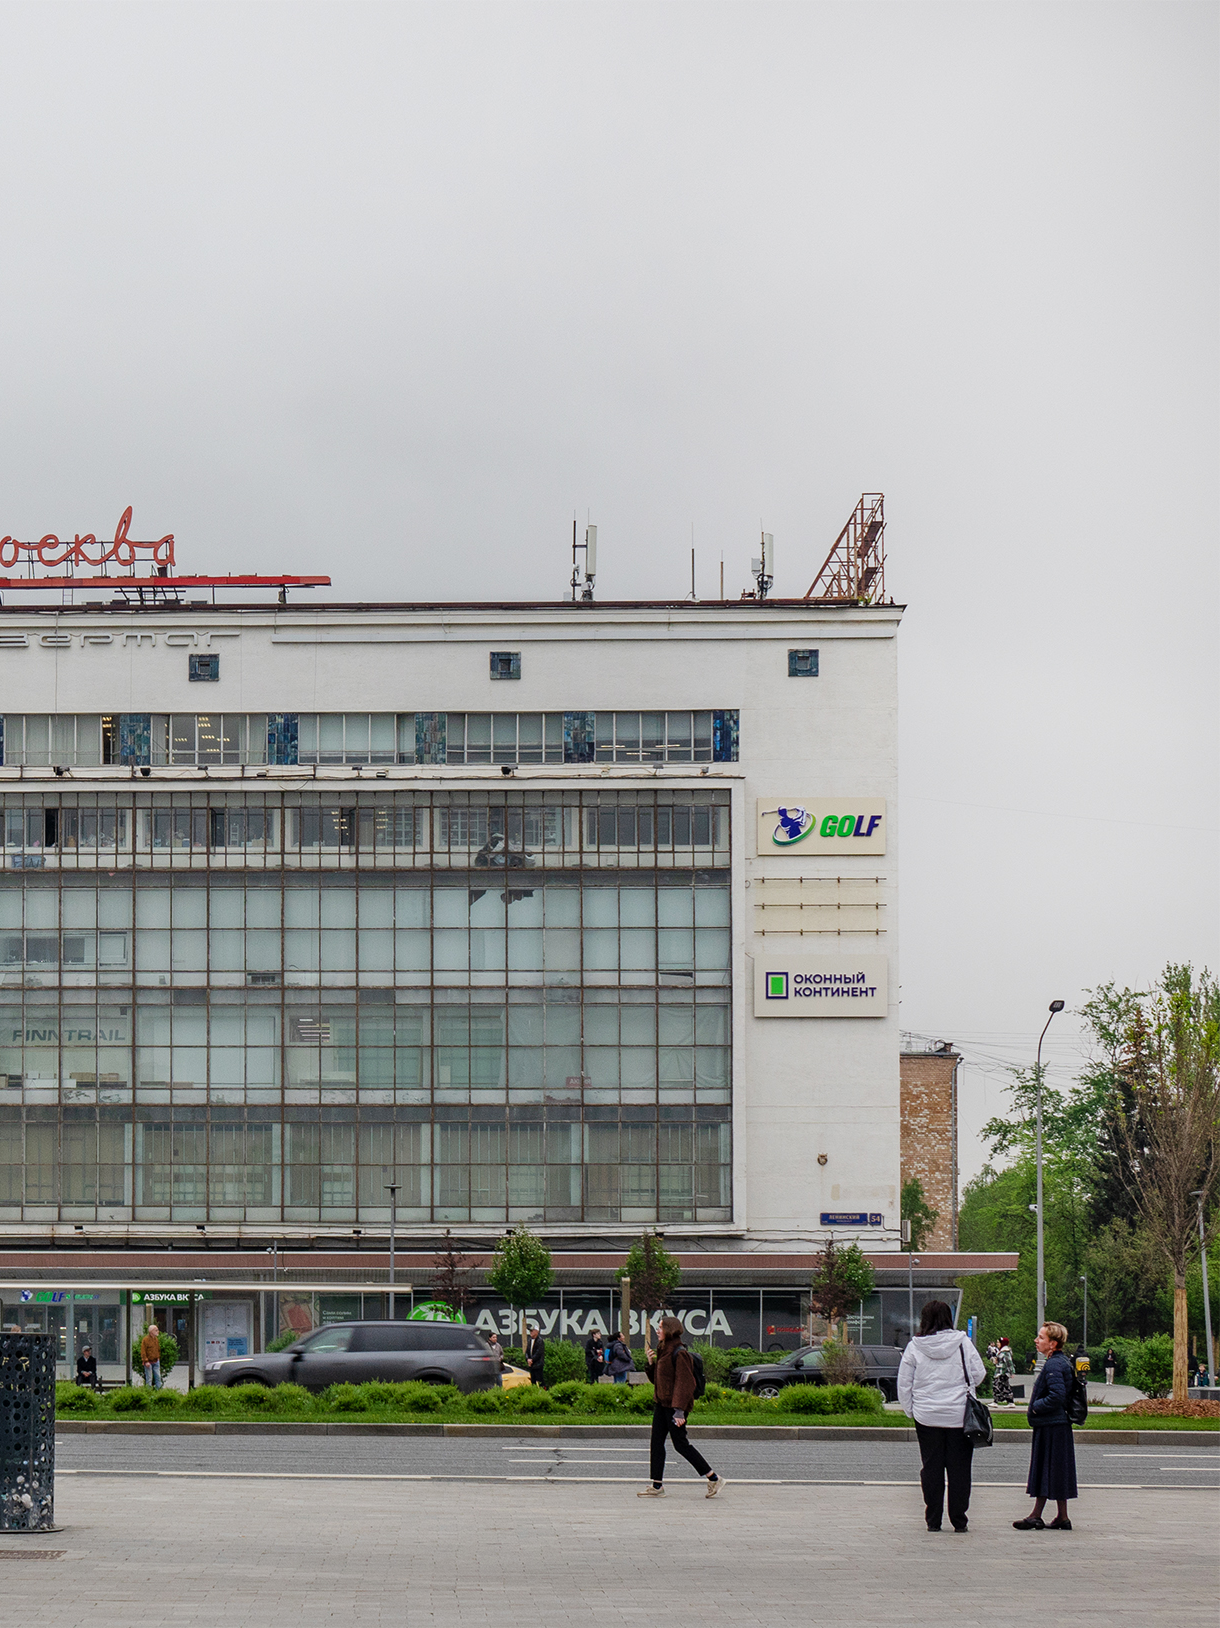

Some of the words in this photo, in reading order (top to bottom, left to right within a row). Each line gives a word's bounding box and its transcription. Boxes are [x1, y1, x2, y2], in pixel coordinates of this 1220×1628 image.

[820, 814, 882, 837] GOLF
[793, 971, 866, 984] ОКОННЫЙ
[793, 986, 877, 998] КОНТИНЕНТ
[36, 1291, 66, 1302] GOLF
[144, 1293, 175, 1301] АЗБУКА
[177, 1293, 204, 1301] ВКСА
[475, 1309, 609, 1335] АЗБУКА
